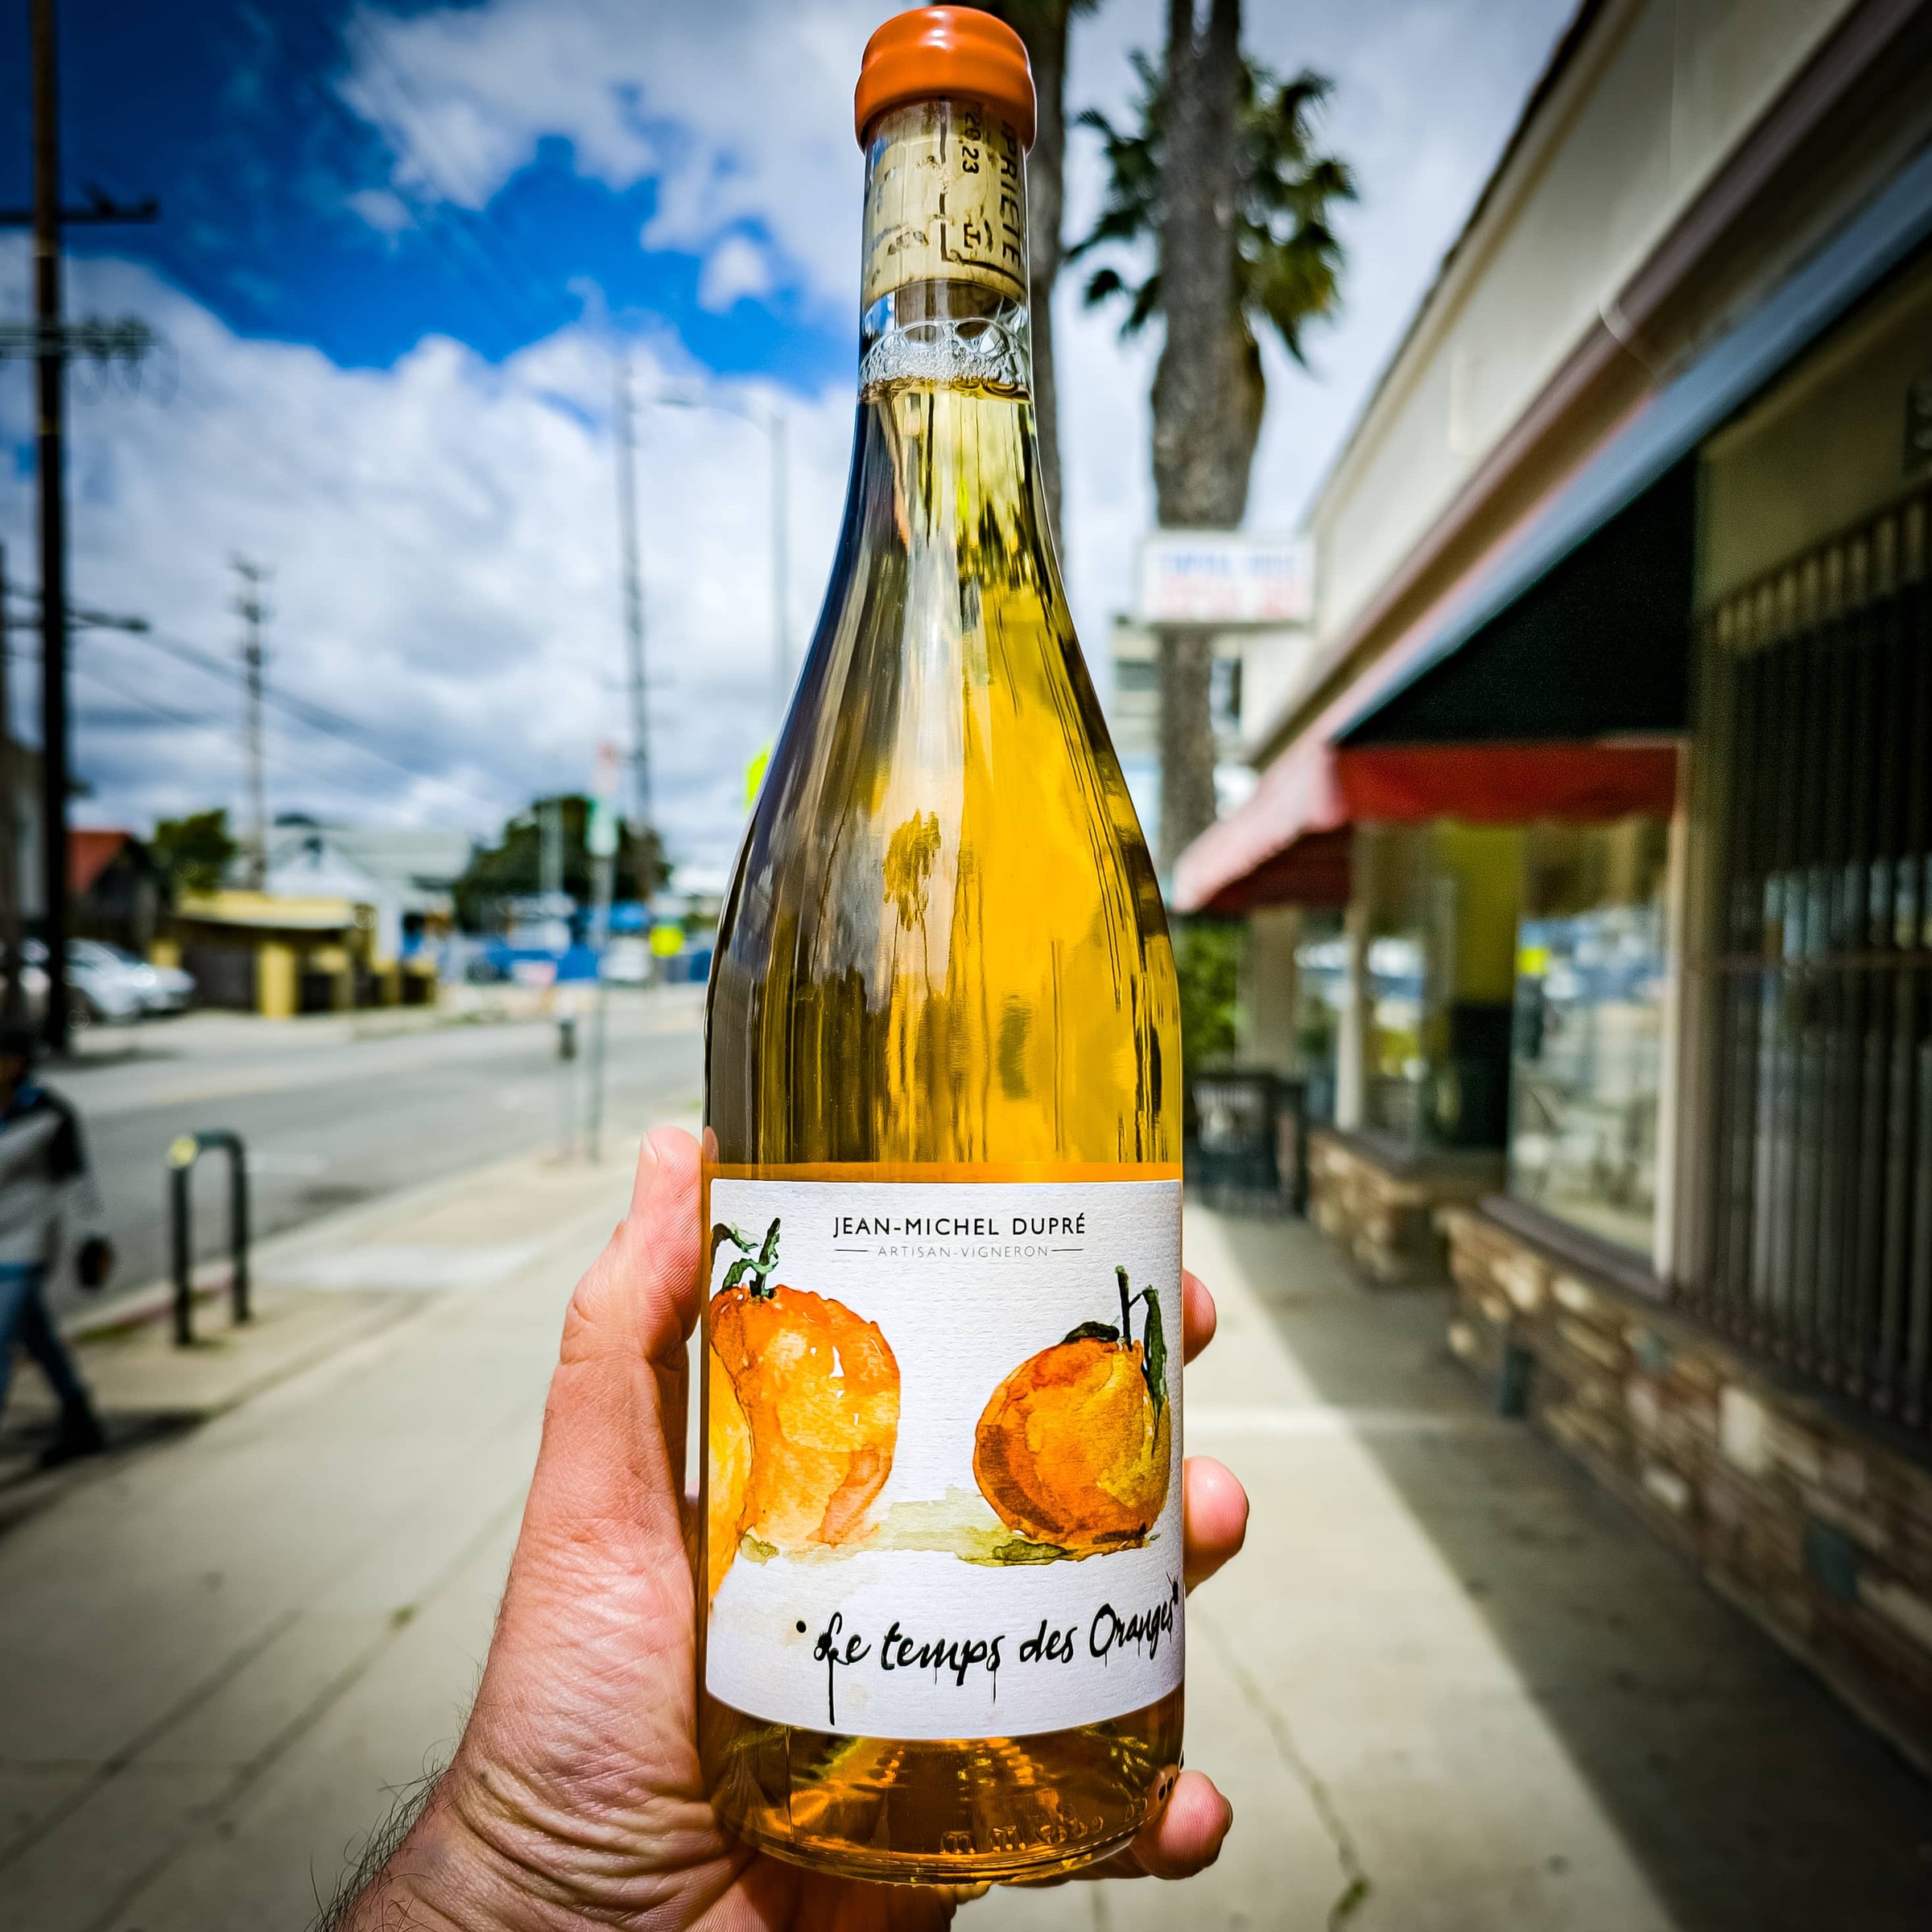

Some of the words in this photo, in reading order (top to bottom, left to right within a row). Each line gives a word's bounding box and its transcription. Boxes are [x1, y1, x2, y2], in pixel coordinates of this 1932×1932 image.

[832, 1216, 1000, 1238] JEAN-MICHEL
[1013, 1212, 1085, 1235] DUPRÉ
[877, 1245, 1048, 1258] ARTISAN-VIGNERON
[881, 1621, 1005, 1703] temps
[1019, 1619, 1078, 1664] des
